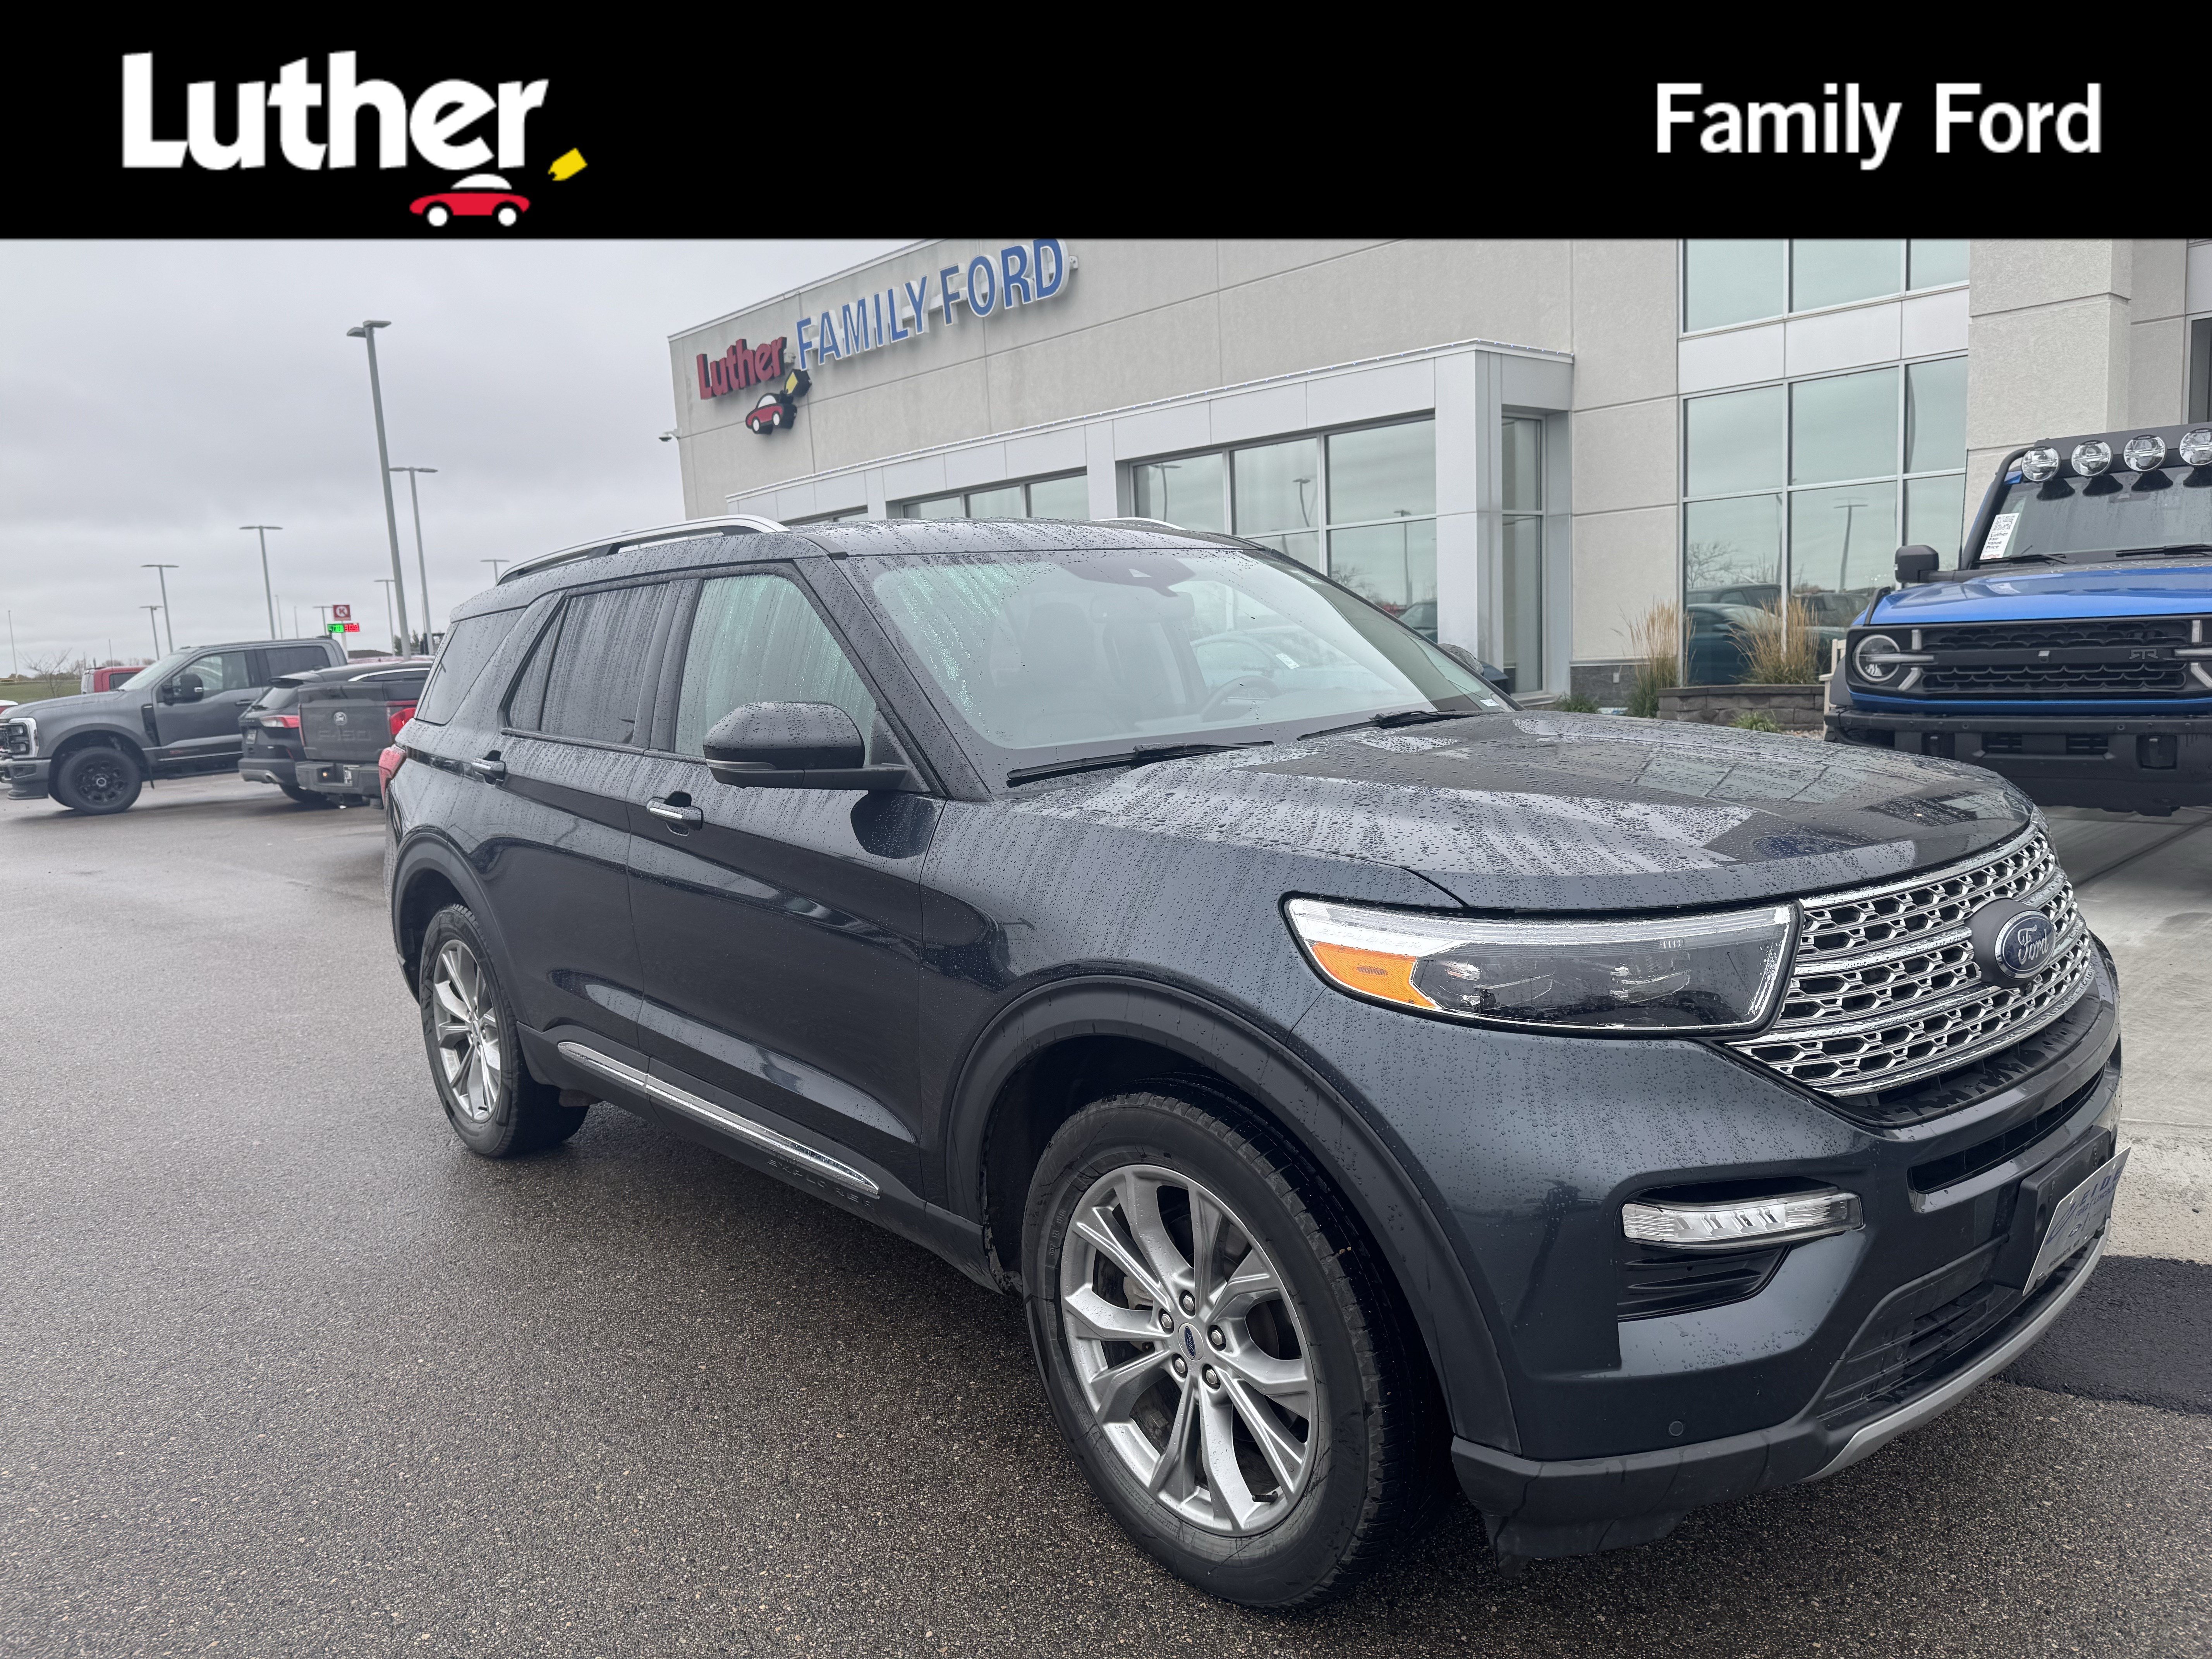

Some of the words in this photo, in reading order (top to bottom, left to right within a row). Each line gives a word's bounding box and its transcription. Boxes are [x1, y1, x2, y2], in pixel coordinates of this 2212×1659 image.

[796, 275, 929, 371] FAMILY
[939, 238, 1065, 326] FORD
[696, 336, 787, 400] Luther
[2017, 924, 2049, 965] Ford
[1186, 1332, 1194, 1352] Ford
